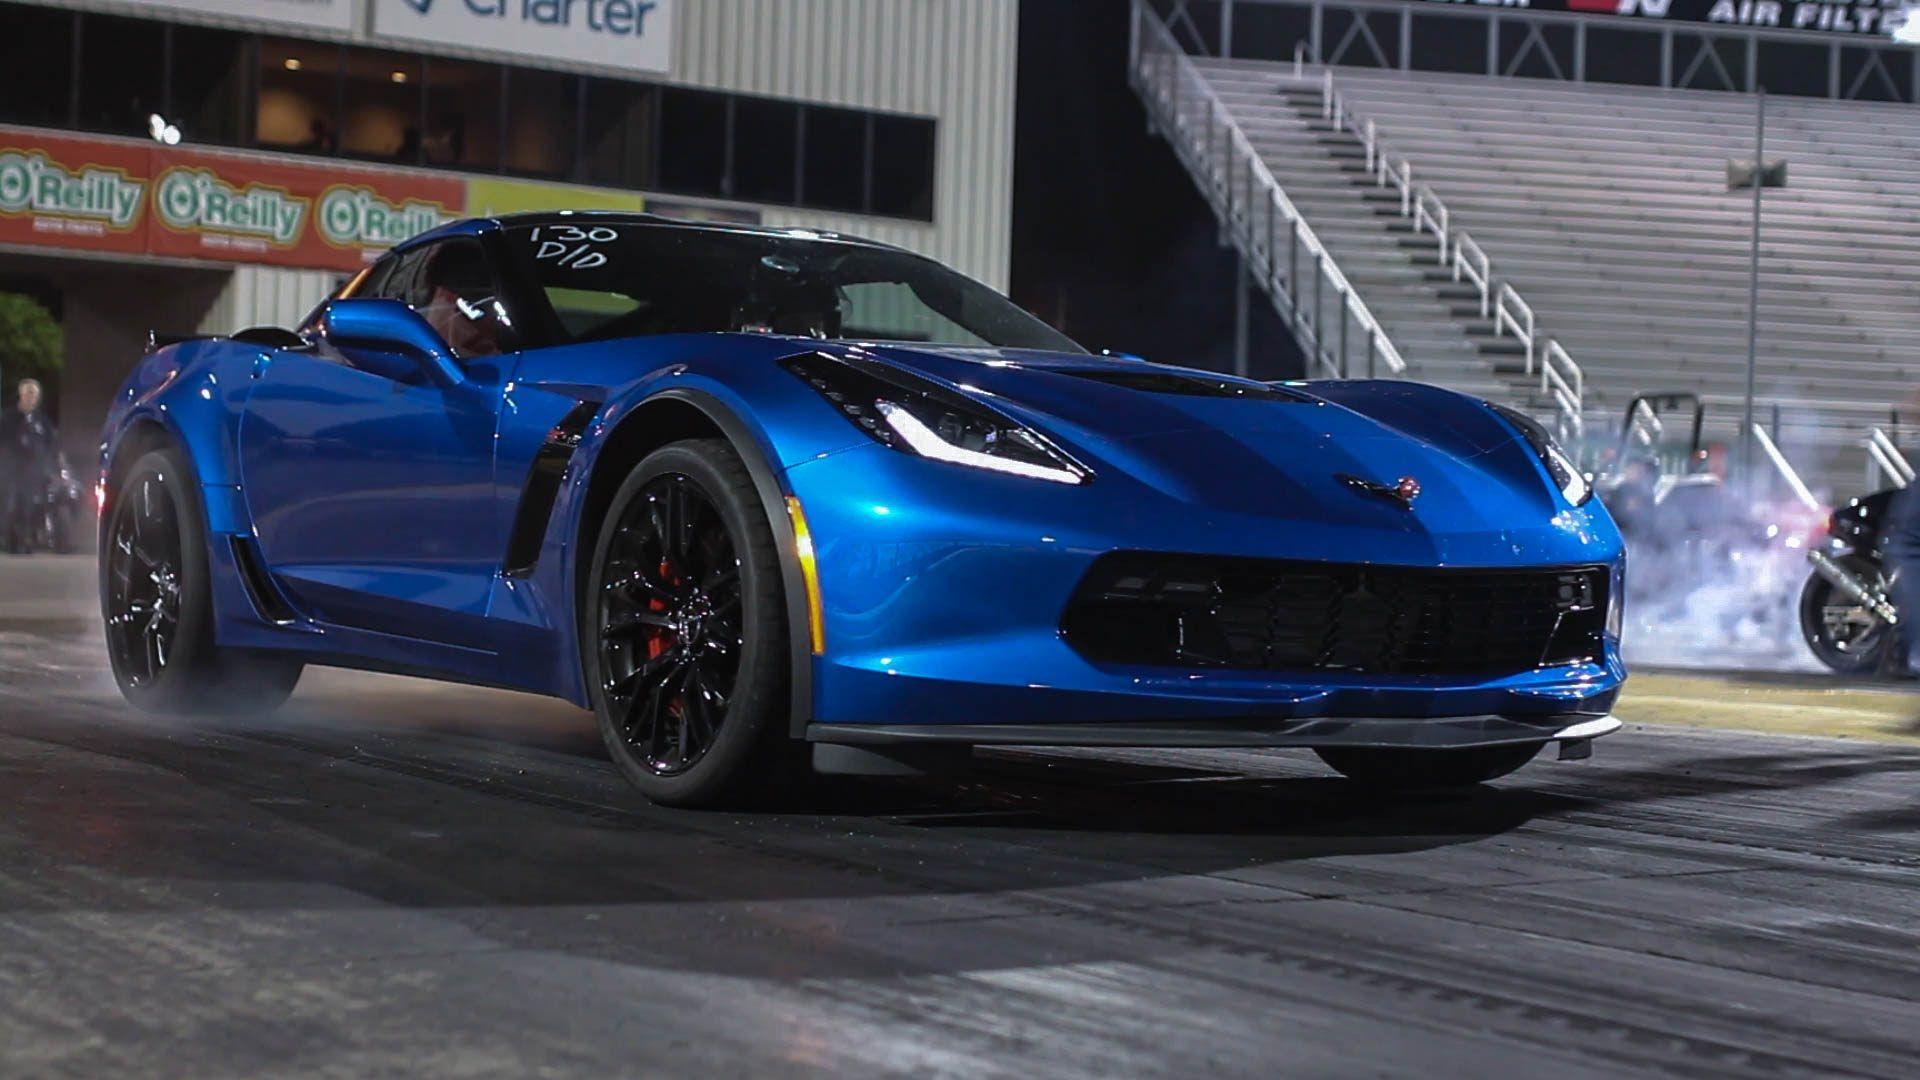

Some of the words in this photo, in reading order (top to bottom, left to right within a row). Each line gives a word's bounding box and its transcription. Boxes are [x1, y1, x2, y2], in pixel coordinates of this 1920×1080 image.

[1707, 0, 1782, 26] AIR
[0, 161, 145, 219] O'Reilly
[164, 177, 304, 237] O'Reilly
[325, 196, 440, 240] O'Reill
[529, 225, 619, 242] 130
